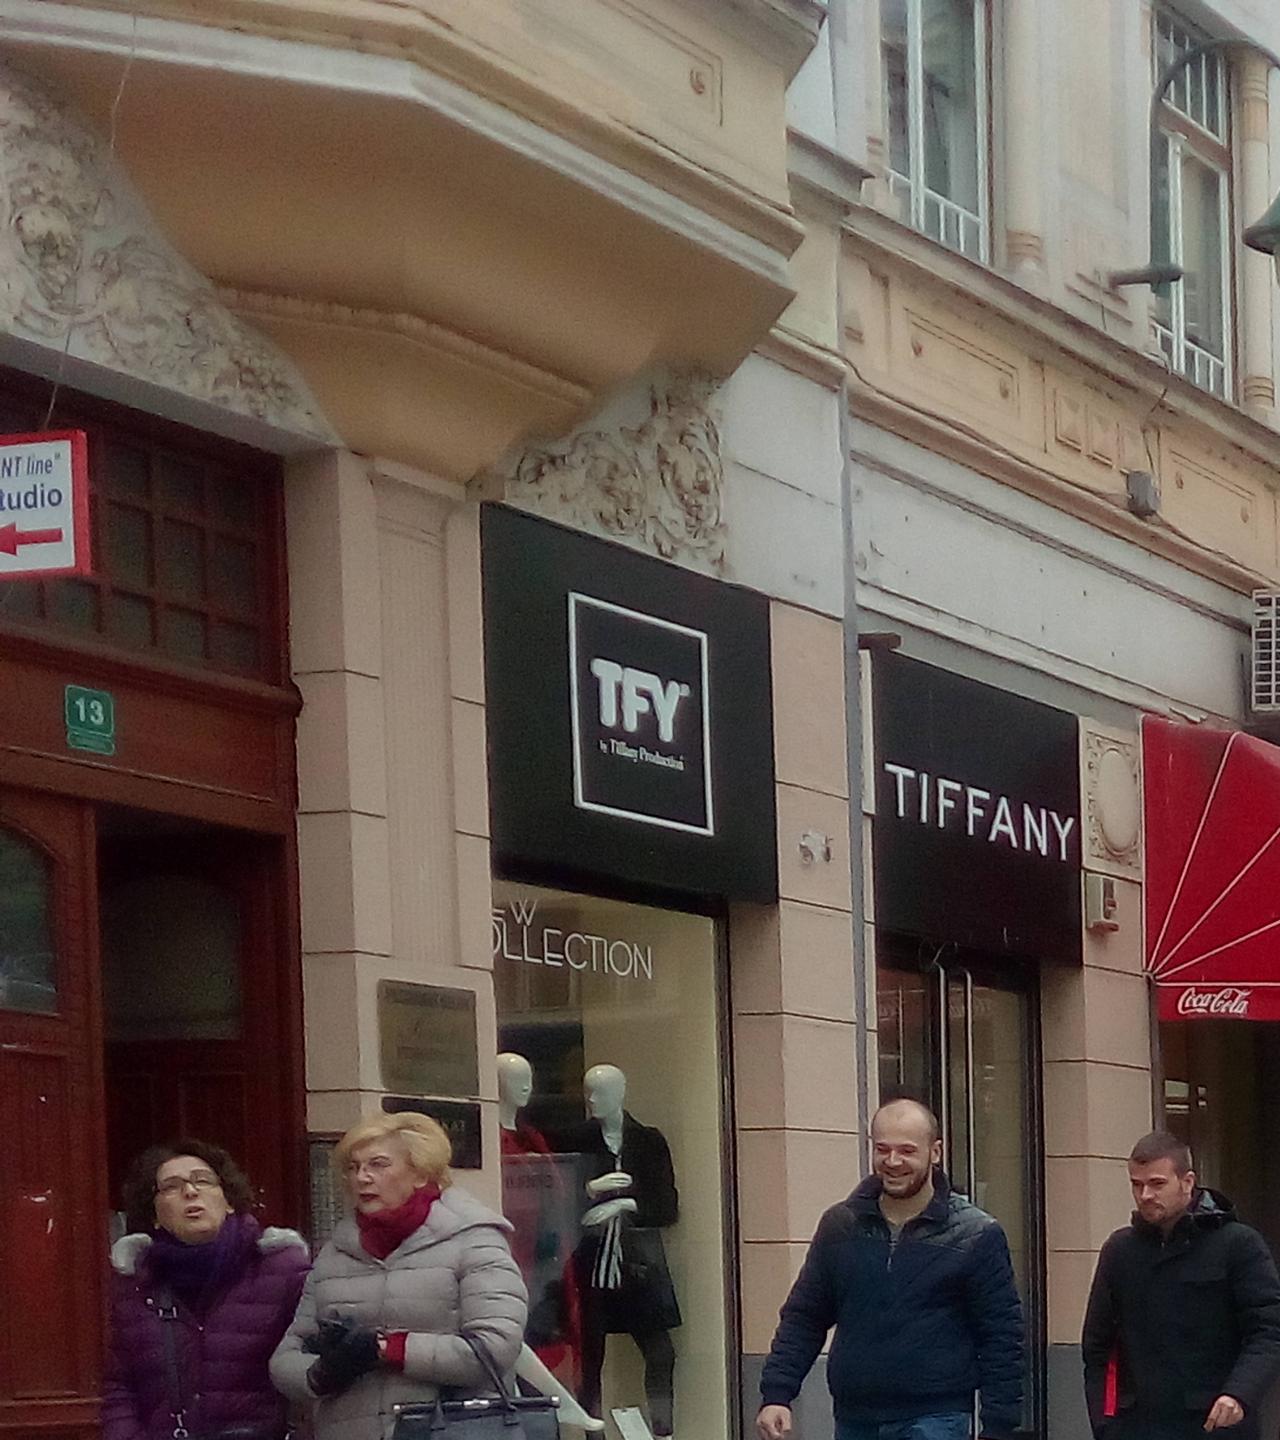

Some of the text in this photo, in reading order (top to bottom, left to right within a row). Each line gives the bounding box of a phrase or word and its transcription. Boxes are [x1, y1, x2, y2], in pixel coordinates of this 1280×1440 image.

[0, 483, 63, 511] tudio
[75, 698, 104, 725] 13
[589, 658, 681, 742] TFY
[885, 762, 1075, 861] TIFFANY
[492, 920, 653, 980] LLECTION
[1177, 987, 1252, 1015] Coca-Cola
